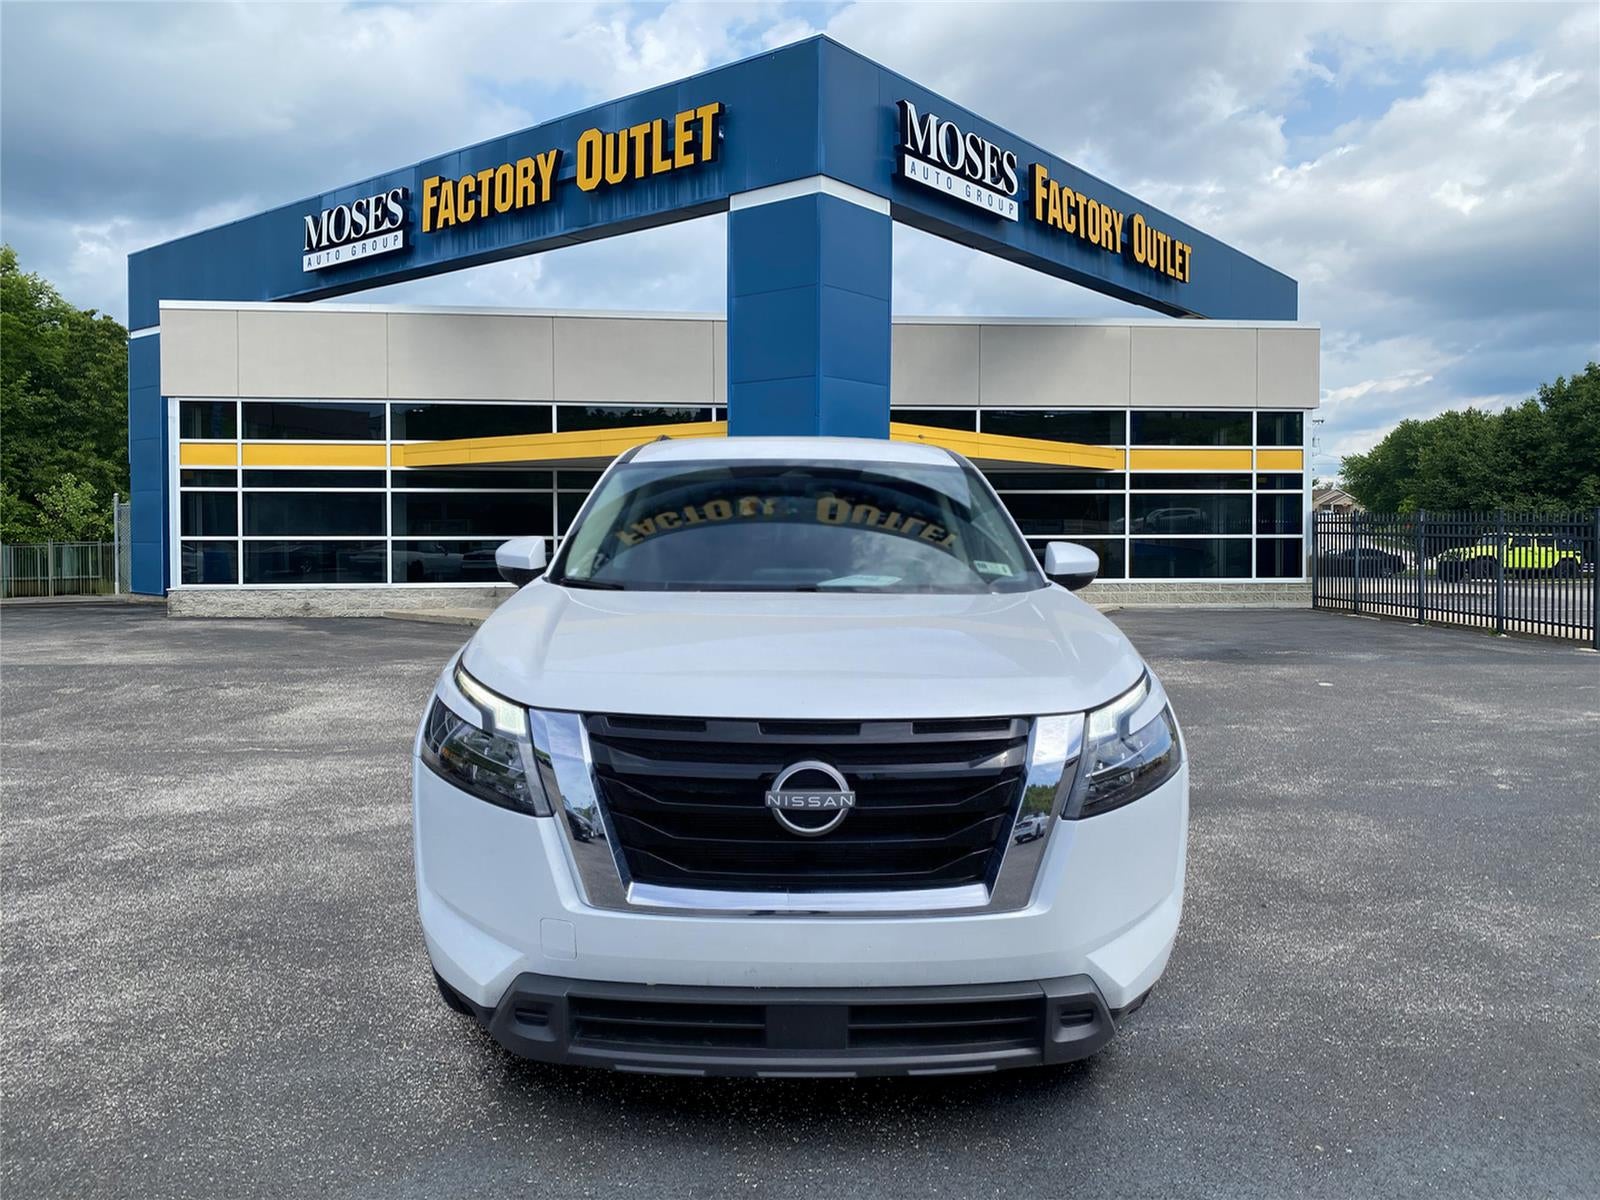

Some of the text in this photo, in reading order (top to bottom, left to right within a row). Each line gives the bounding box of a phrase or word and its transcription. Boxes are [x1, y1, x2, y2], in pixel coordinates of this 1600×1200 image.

[422, 102, 720, 233] FACTORY OUTLET
[904, 100, 1019, 196] MOSES
[910, 161, 1015, 214] AUTO GROUP
[303, 188, 404, 251] MOSES
[1035, 163, 1192, 283] FACTORY OUTLET
[307, 235, 400, 268] AUTO GROUP
[767, 795, 853, 807] NISSAN
